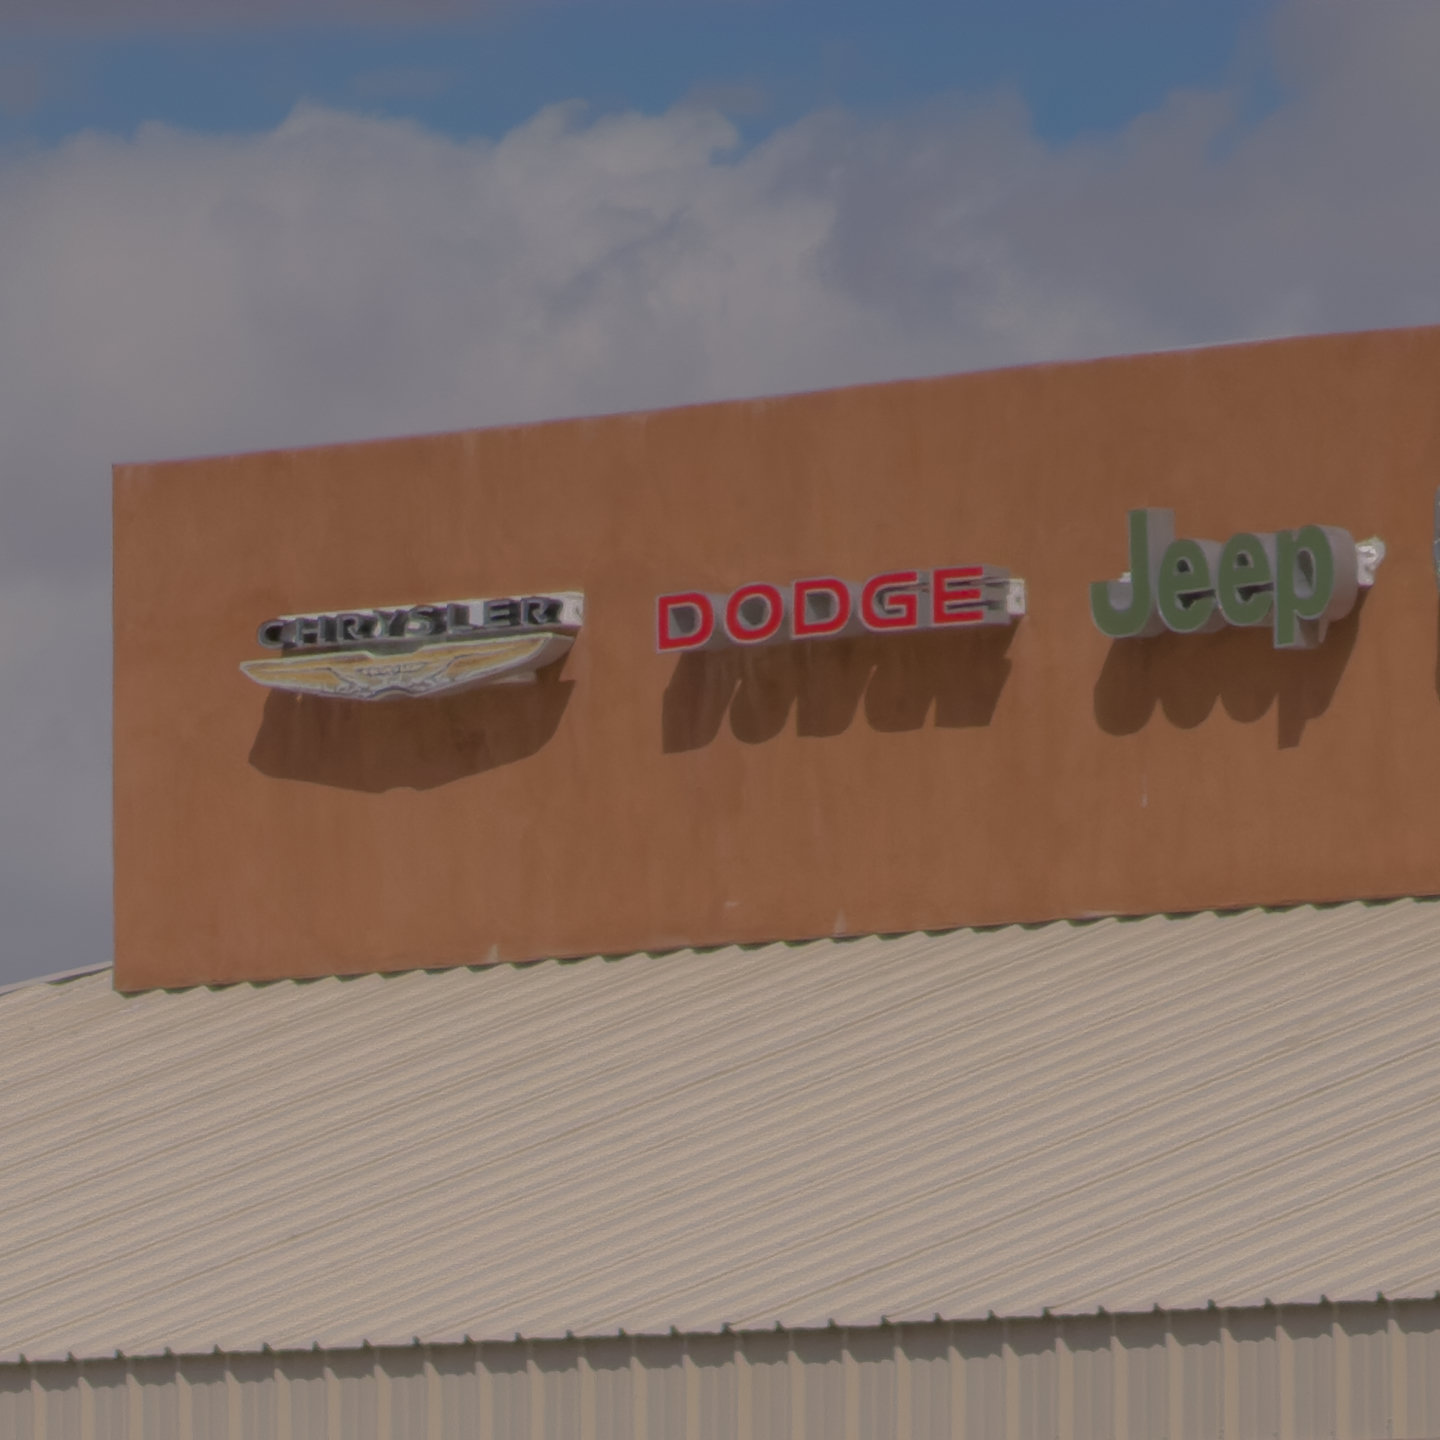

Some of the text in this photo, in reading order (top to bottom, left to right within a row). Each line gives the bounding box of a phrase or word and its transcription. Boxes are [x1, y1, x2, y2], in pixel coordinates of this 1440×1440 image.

[256, 594, 565, 651] CHRYSLER
[656, 565, 988, 653] DODGE
[1089, 507, 1336, 650] Jeep
